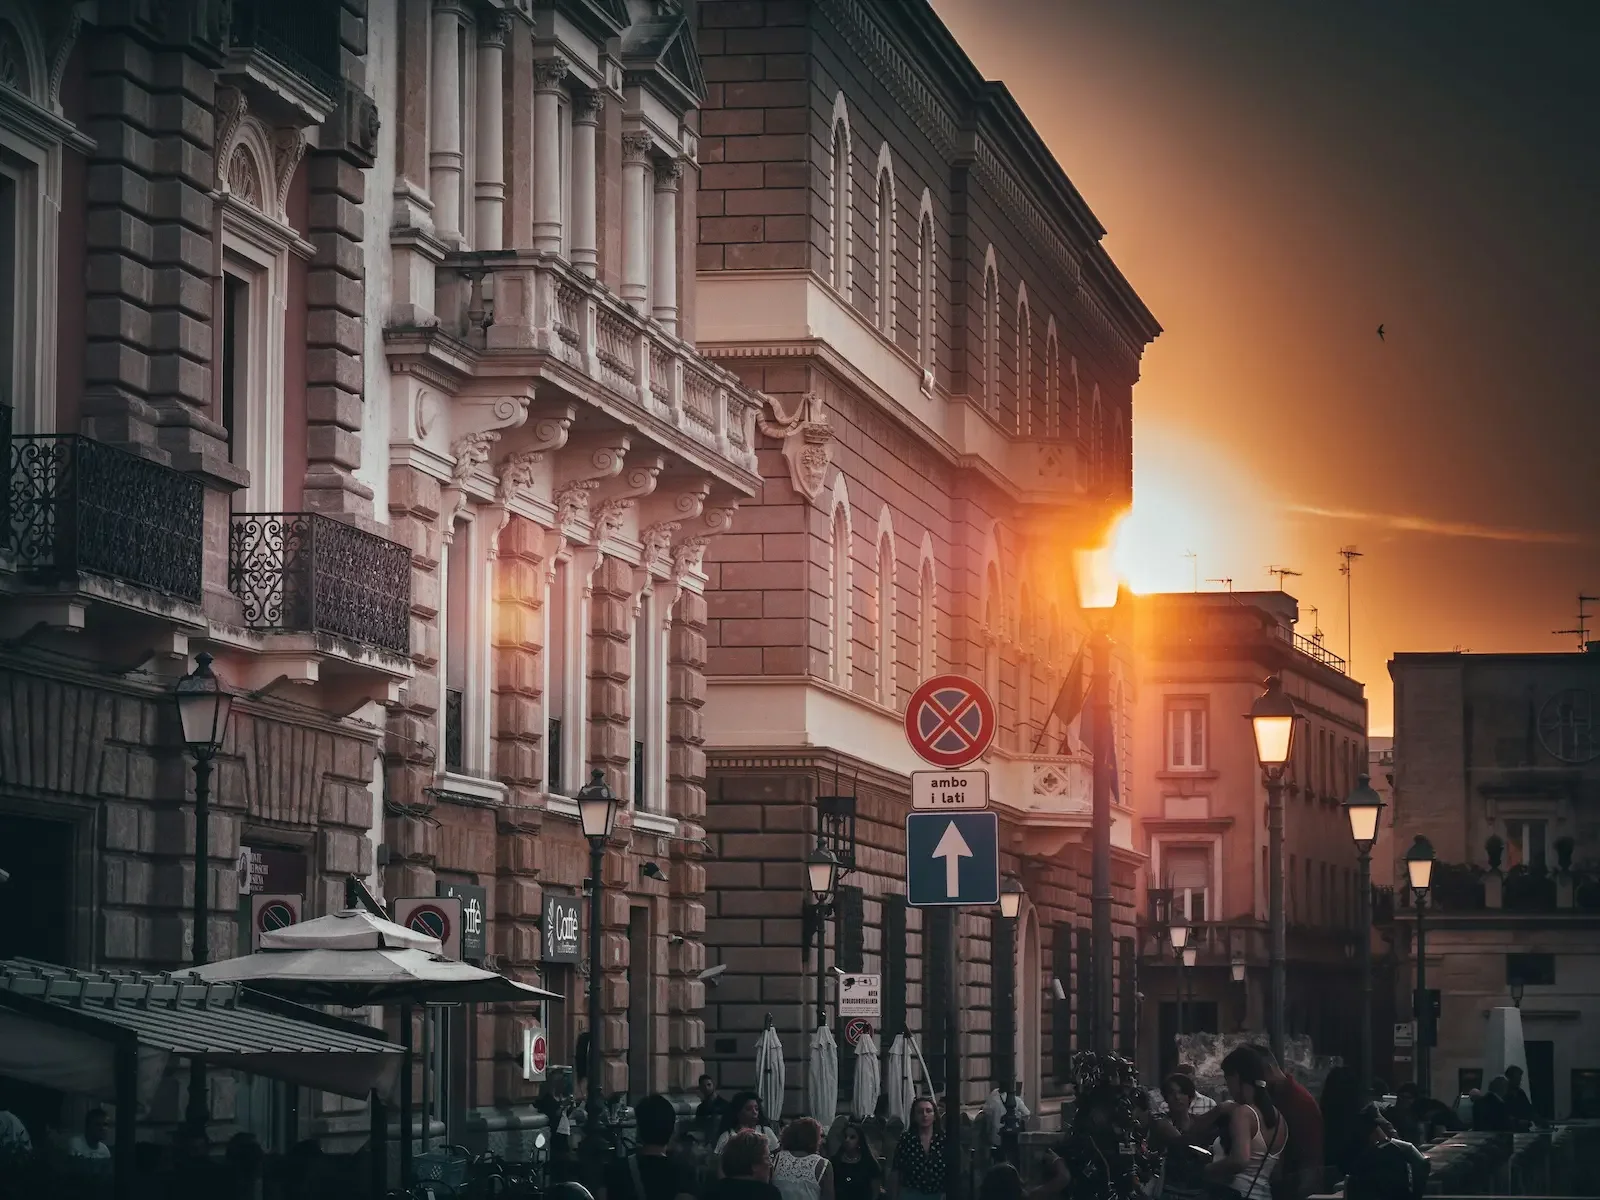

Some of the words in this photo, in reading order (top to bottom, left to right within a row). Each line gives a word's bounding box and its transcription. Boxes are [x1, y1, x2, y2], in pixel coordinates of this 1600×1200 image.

[931, 777, 967, 787] ambo
[931, 793, 935, 803] i
[942, 793, 965, 803] lati
[556, 904, 579, 941] Caffè
